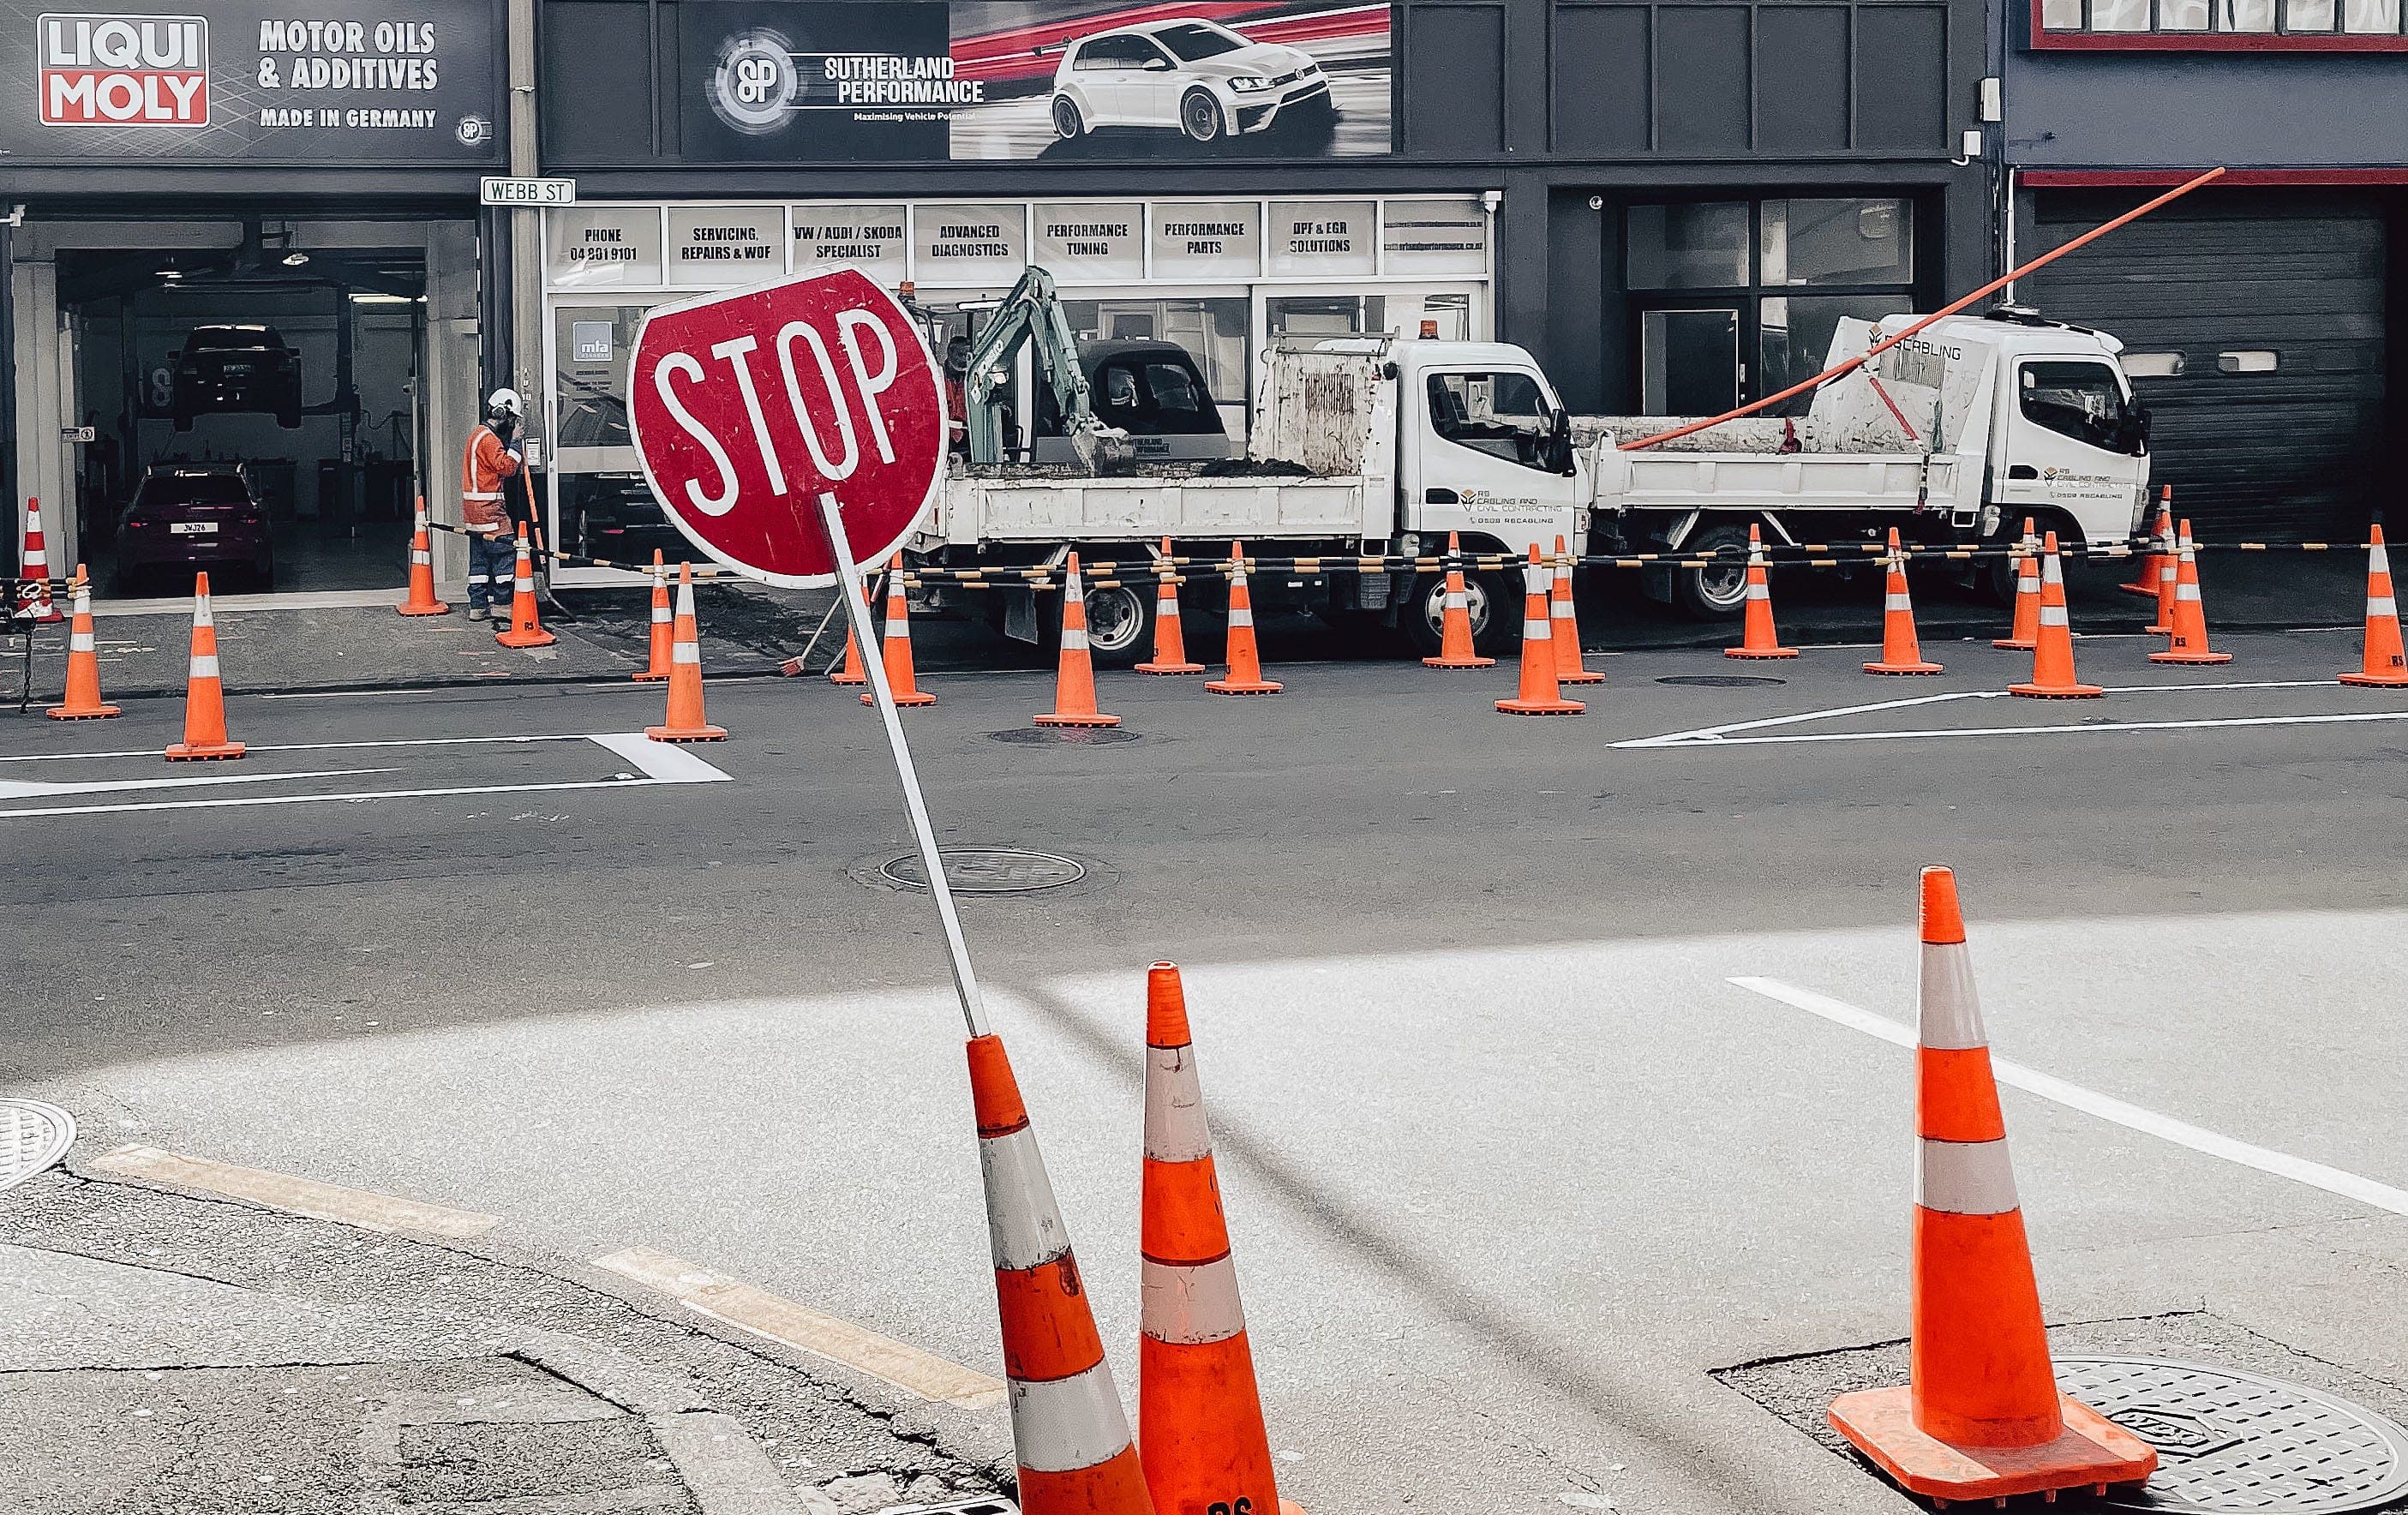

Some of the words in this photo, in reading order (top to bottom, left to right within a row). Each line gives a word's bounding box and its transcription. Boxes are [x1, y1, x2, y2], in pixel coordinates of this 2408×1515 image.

[258, 20, 366, 53] MOTOR
[374, 21, 436, 54] OILS
[48, 20, 199, 70] LIQUI
[257, 56, 281, 89] &
[290, 57, 439, 90] ADDITIVES
[824, 57, 955, 80] SUTHERLAND
[50, 73, 204, 120] MOLY
[838, 80, 985, 103] PERFORMANCE
[260, 108, 314, 127] MADE
[320, 108, 340, 127] IN
[345, 108, 437, 129] GERMANY
[854, 112, 903, 122] Maximising
[905, 112, 936, 121] Vehicle
[937, 112, 976, 121] Potential
[491, 183, 538, 200] WEBB
[546, 183, 565, 201] ST
[692, 227, 759, 242] SERVICING,
[794, 226, 815, 240] VW
[817, 226, 823, 240] /
[824, 226, 853, 239] AUDI
[855, 226, 861, 239] /
[864, 226, 902, 239] SKODA
[939, 225, 999, 239] ADVANCED
[1046, 224, 1128, 237] PERFORMANCE
[1165, 223, 1244, 237] PERFORMANCE
[1293, 222, 1313, 235] DPF
[1315, 223, 1323, 235] &
[1326, 221, 1347, 235] EGR
[584, 229, 622, 242] PHONE
[570, 247, 585, 260] 04
[611, 247, 637, 260] 9101
[681, 246, 731, 260] REPAIRS
[733, 248, 742, 260] &
[744, 246, 771, 260] WOF
[816, 244, 881, 258] SPECIALIST
[931, 243, 1009, 257] DIAGNOSTICS
[1067, 242, 1109, 255] TUNING
[1187, 241, 1222, 254] PARTS
[1290, 239, 1351, 254] SOLUTIONS
[654, 308, 898, 517] STOP
[2175, 637, 2187, 647] RS
[2391, 655, 2405, 667] RS
